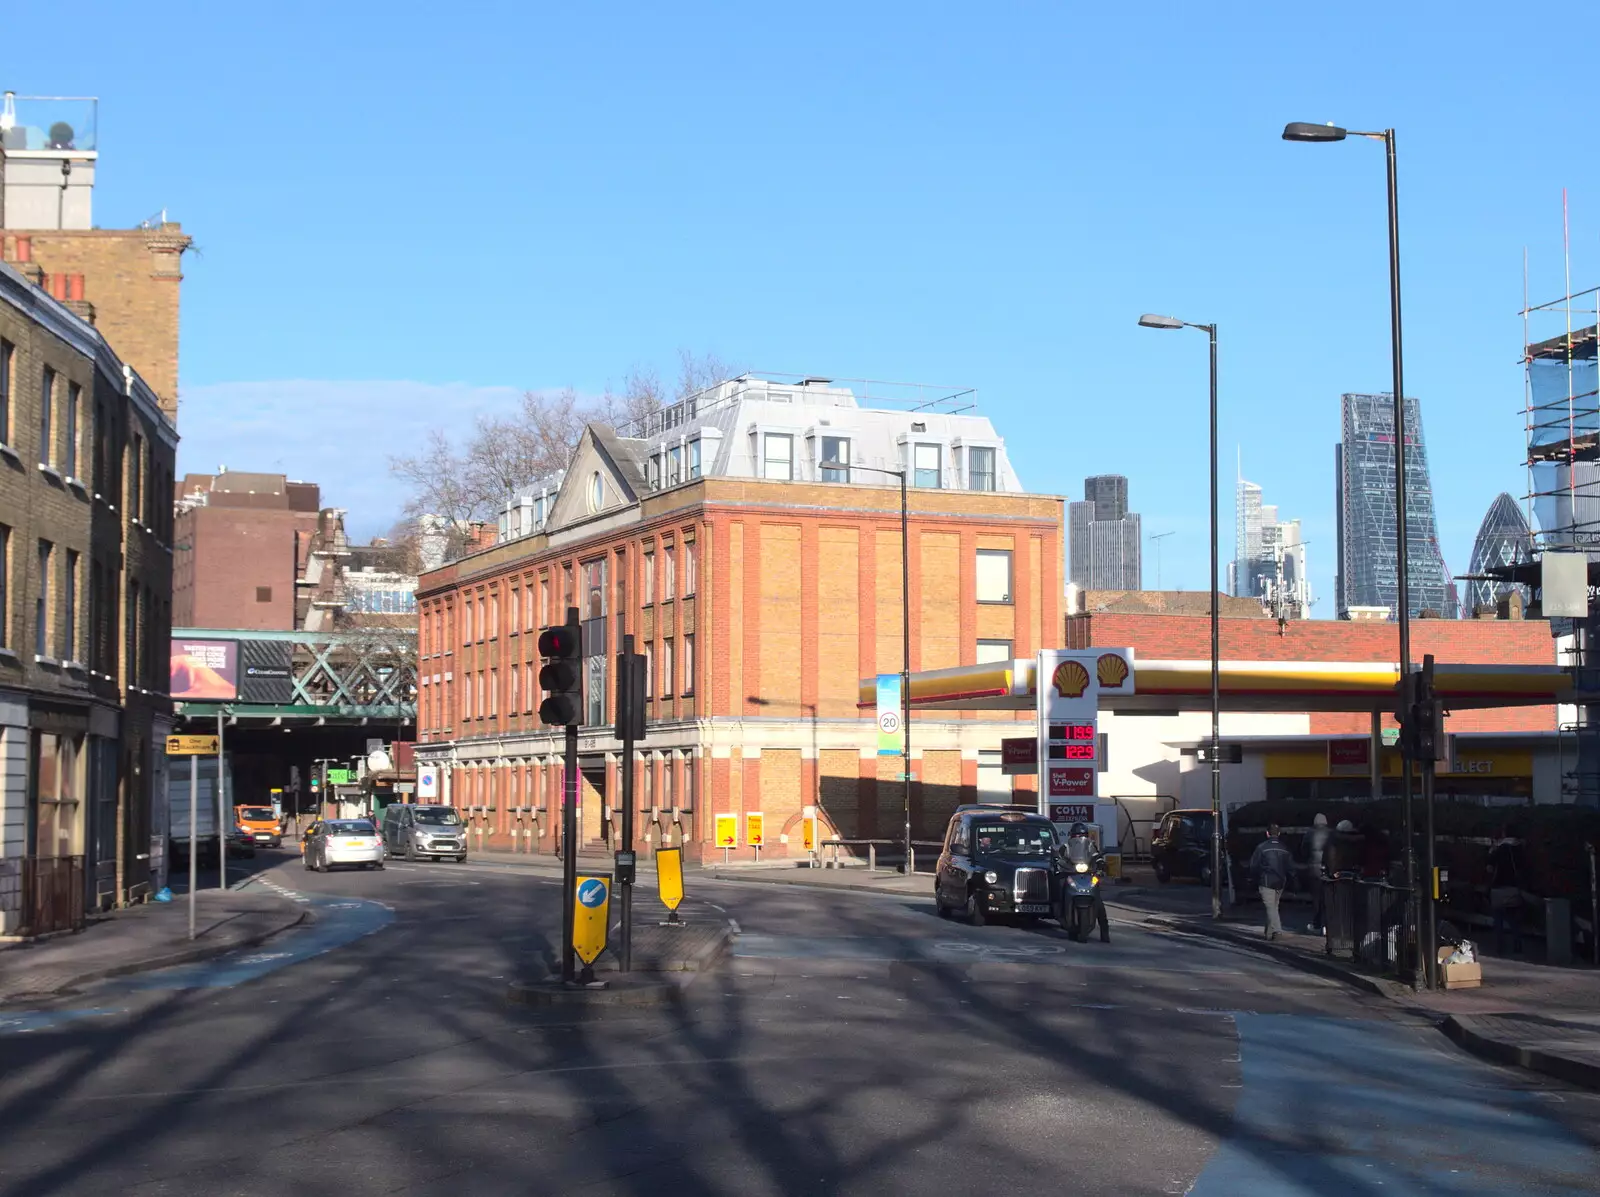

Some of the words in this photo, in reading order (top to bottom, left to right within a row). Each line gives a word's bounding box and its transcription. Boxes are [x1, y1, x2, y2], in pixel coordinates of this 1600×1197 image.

[883, 717, 896, 728] 20
[1454, 760, 1493, 772] ELECT
[1053, 778, 1088, 786] V-Power
[1056, 806, 1088, 815] COSTA
